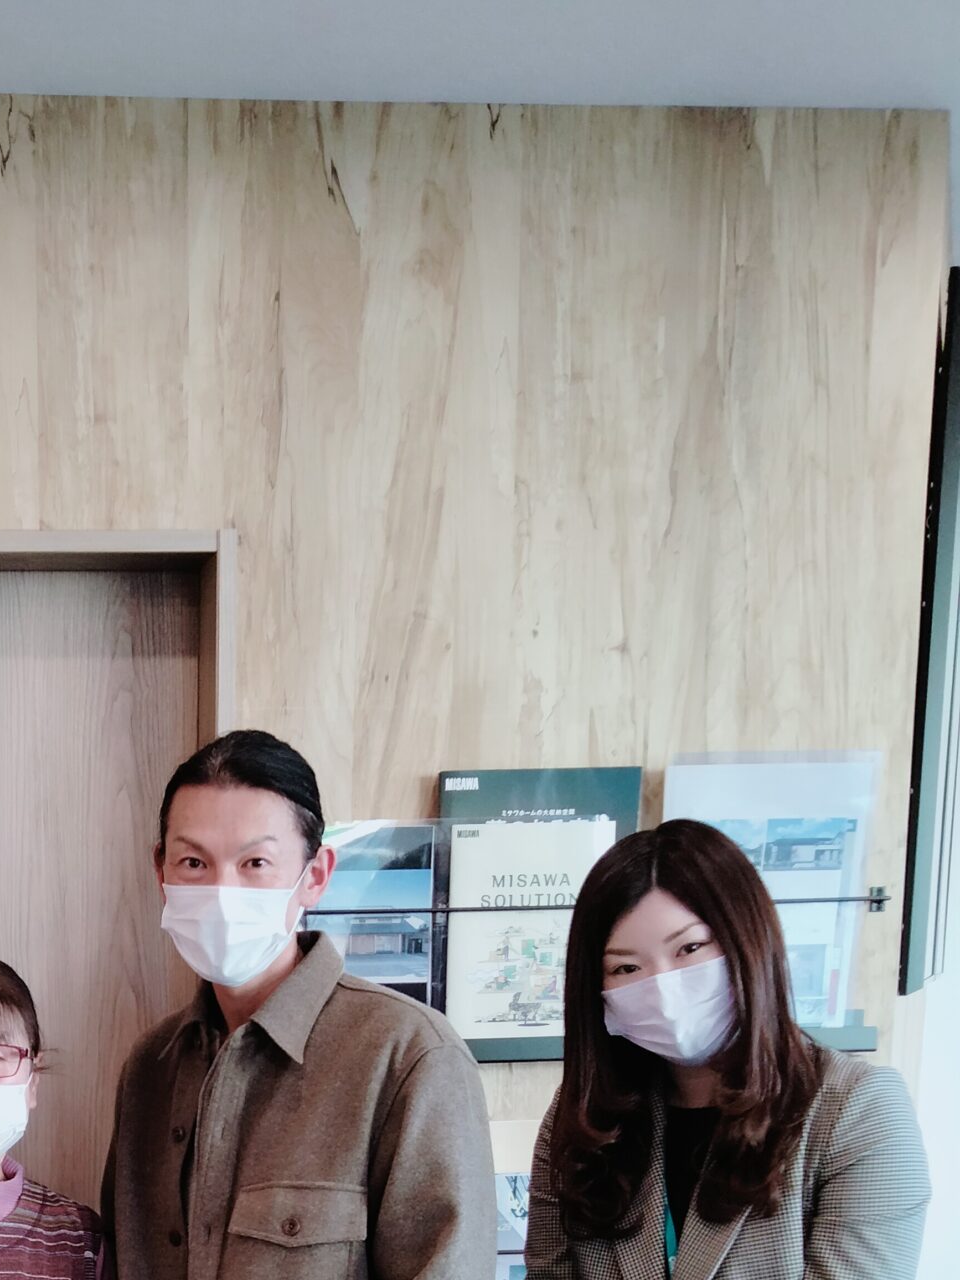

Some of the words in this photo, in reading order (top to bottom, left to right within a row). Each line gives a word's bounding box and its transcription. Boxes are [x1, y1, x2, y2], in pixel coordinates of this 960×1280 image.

[445, 777, 479, 791] MISAWA
[457, 830, 480, 839] MISAWA
[491, 873, 571, 888] MISAWA
